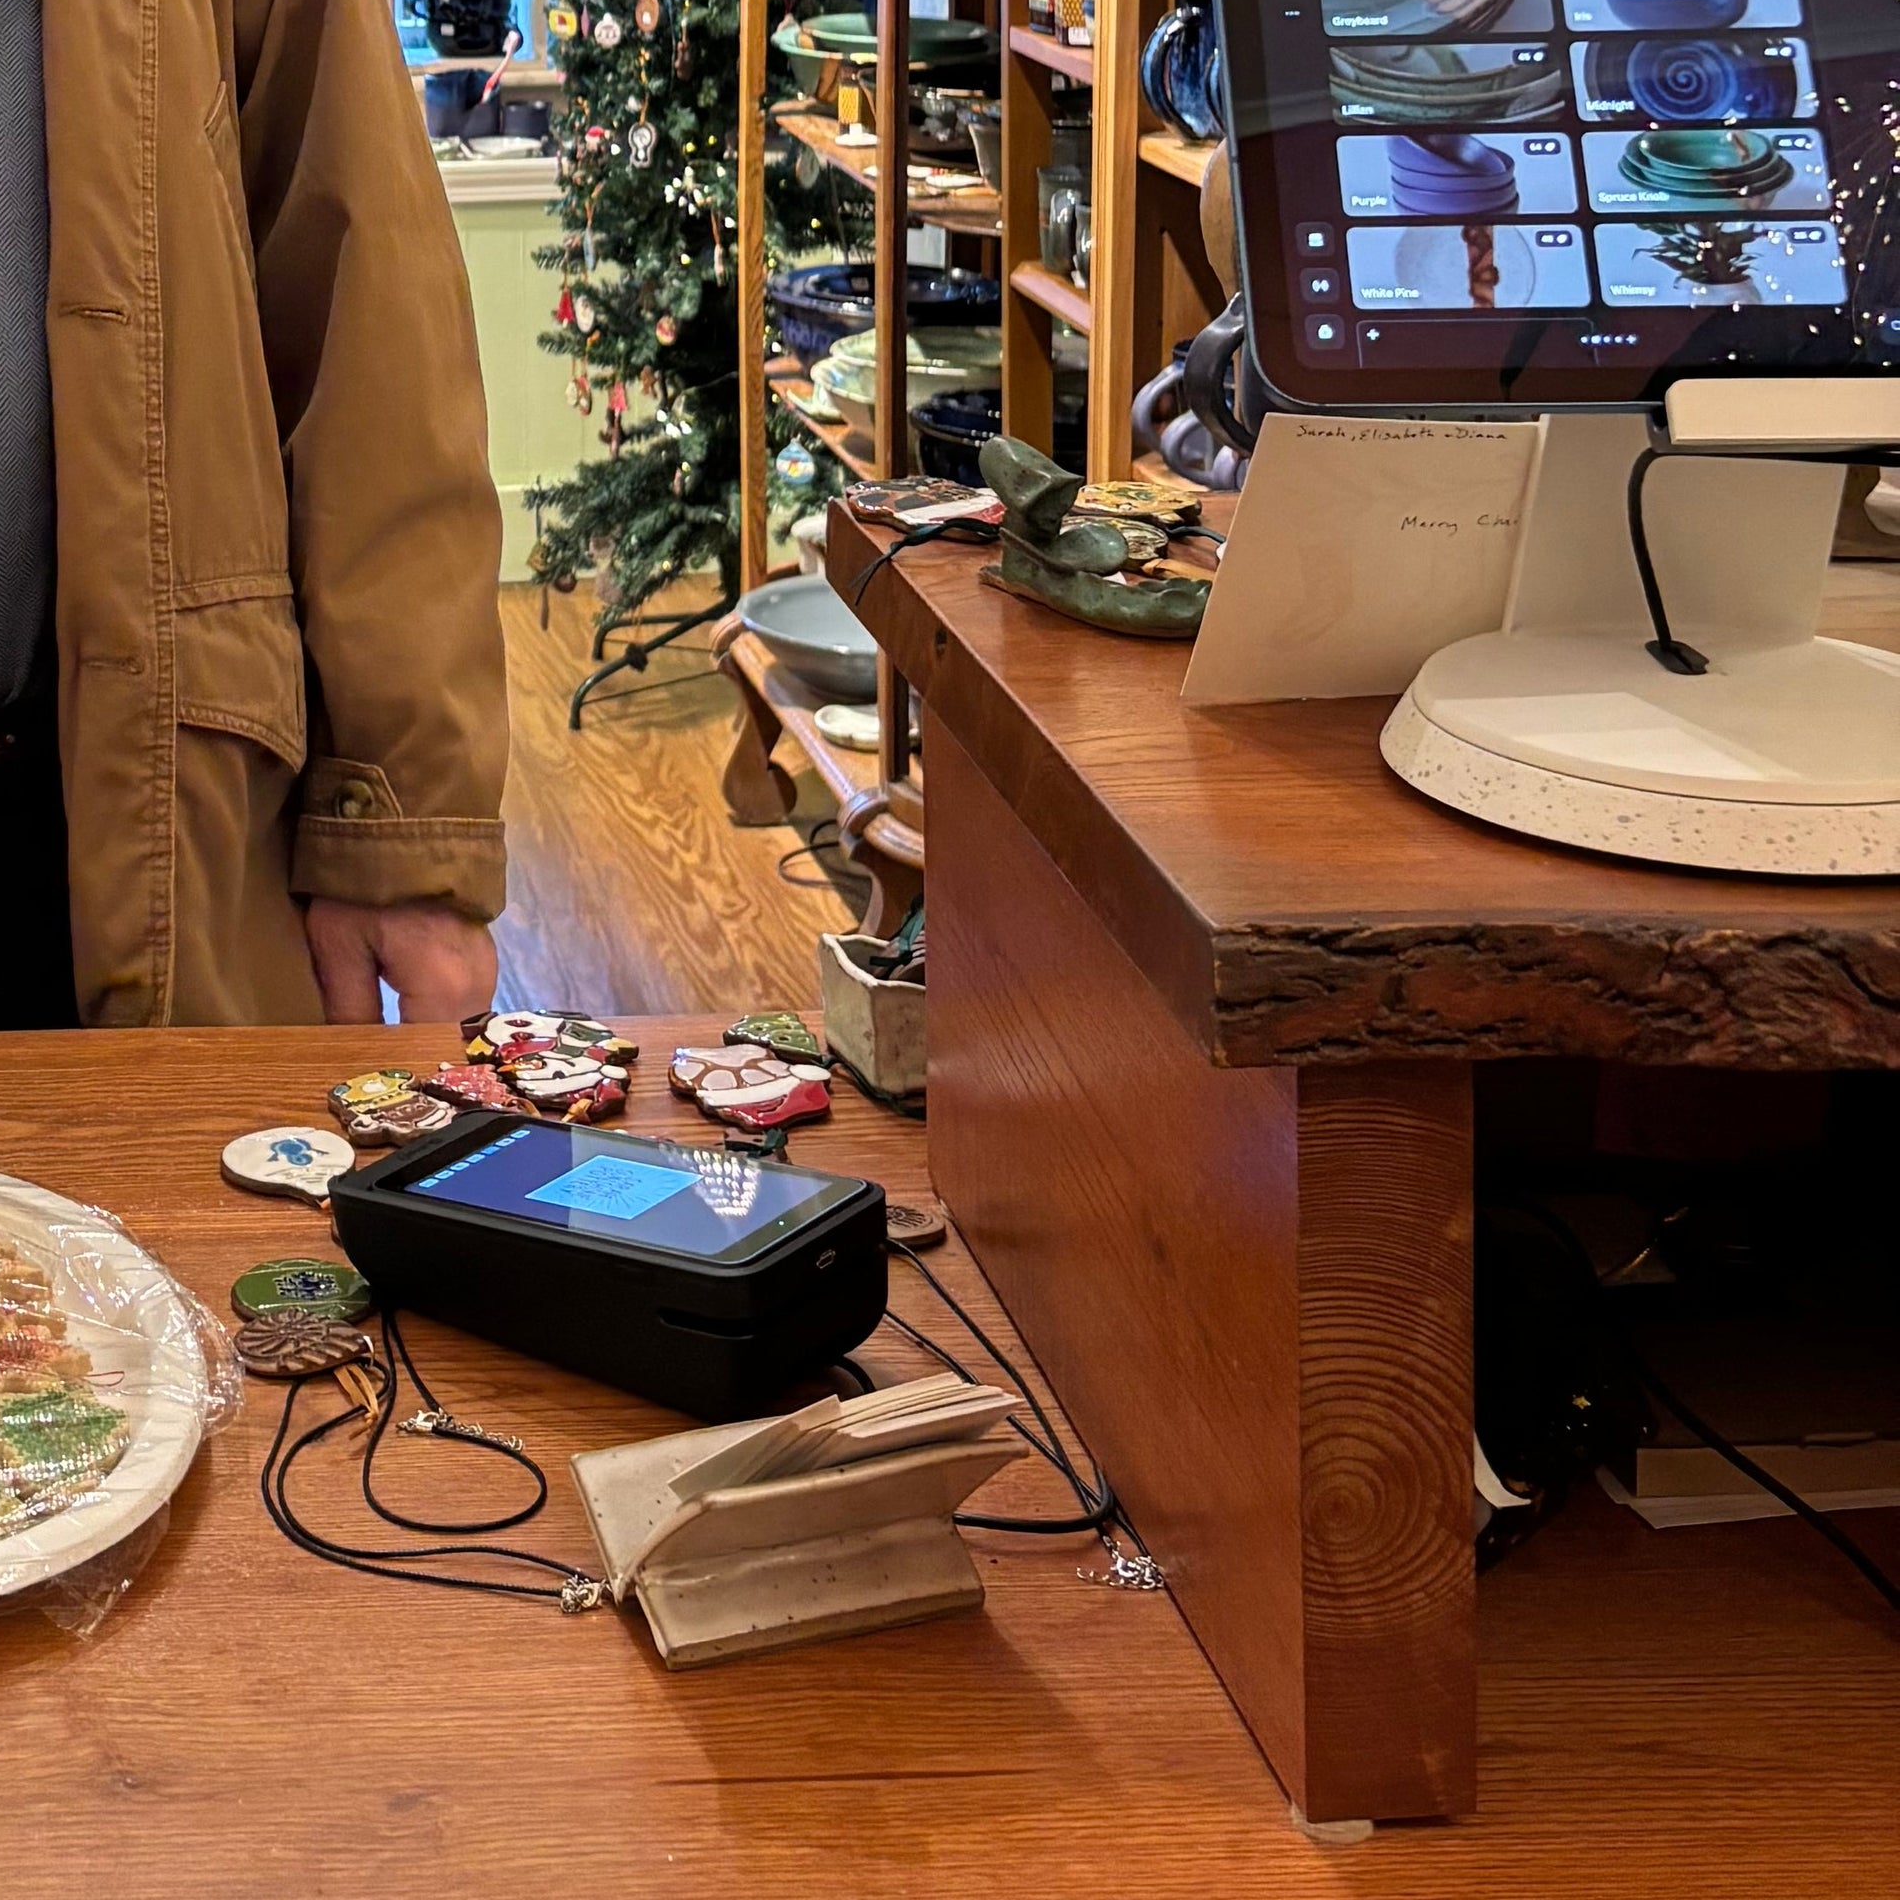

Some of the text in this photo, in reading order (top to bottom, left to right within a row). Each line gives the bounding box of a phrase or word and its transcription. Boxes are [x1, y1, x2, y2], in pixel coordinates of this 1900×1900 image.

[1574, 11, 1593, 22] Iris
[1586, 99, 1635, 113] Midnight
[1351, 195, 1387, 208] Purple
[1598, 190, 1670, 204] Spruce Knob
[1361, 287, 1420, 299] White Pine
[1610, 284, 1656, 297] Whimsy
